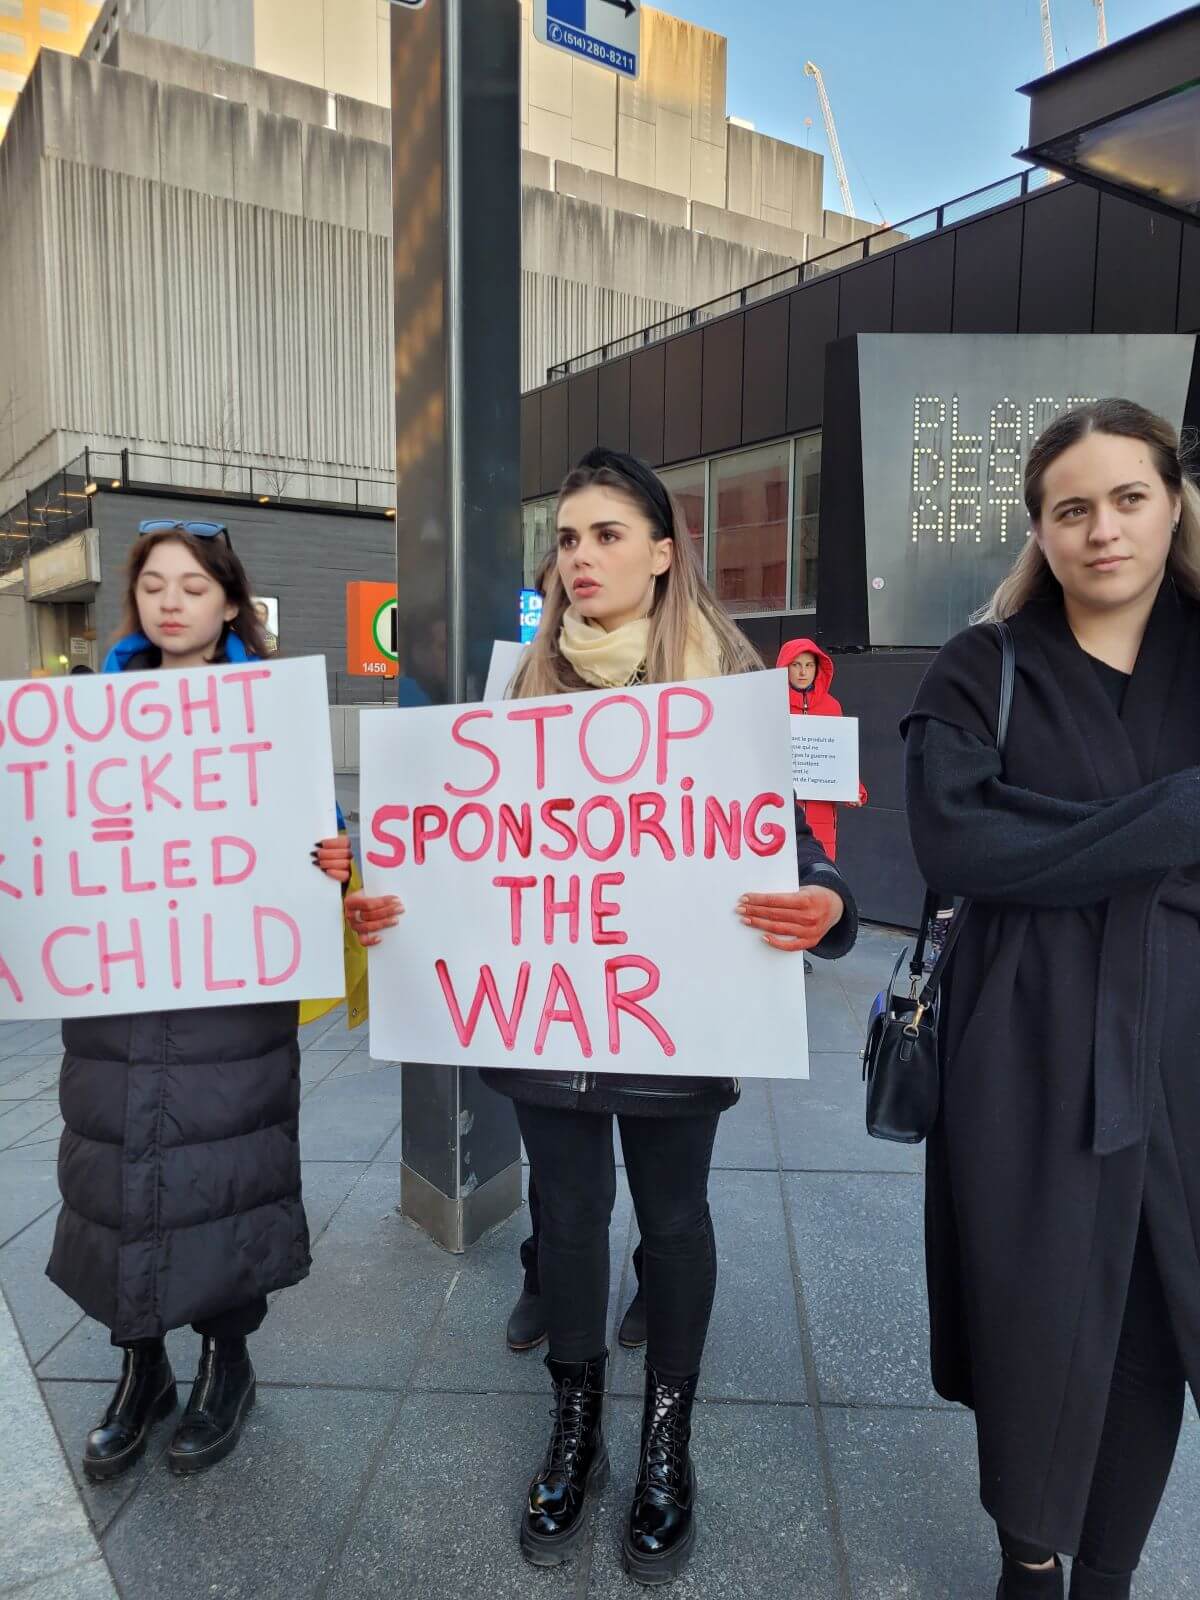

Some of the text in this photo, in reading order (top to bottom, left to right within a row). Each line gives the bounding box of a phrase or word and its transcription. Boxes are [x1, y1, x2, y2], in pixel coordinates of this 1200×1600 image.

[564, 30, 633, 70] (514) 280-8211
[912, 448, 1021, 492] DES
[911, 498, 1032, 543] ART
[363, 662, 387, 673] 1450
[0, 669, 272, 747] OUGHT
[443, 687, 714, 799] STOP
[492, 871, 629, 947] THE
[434, 954, 677, 1058] WAR
